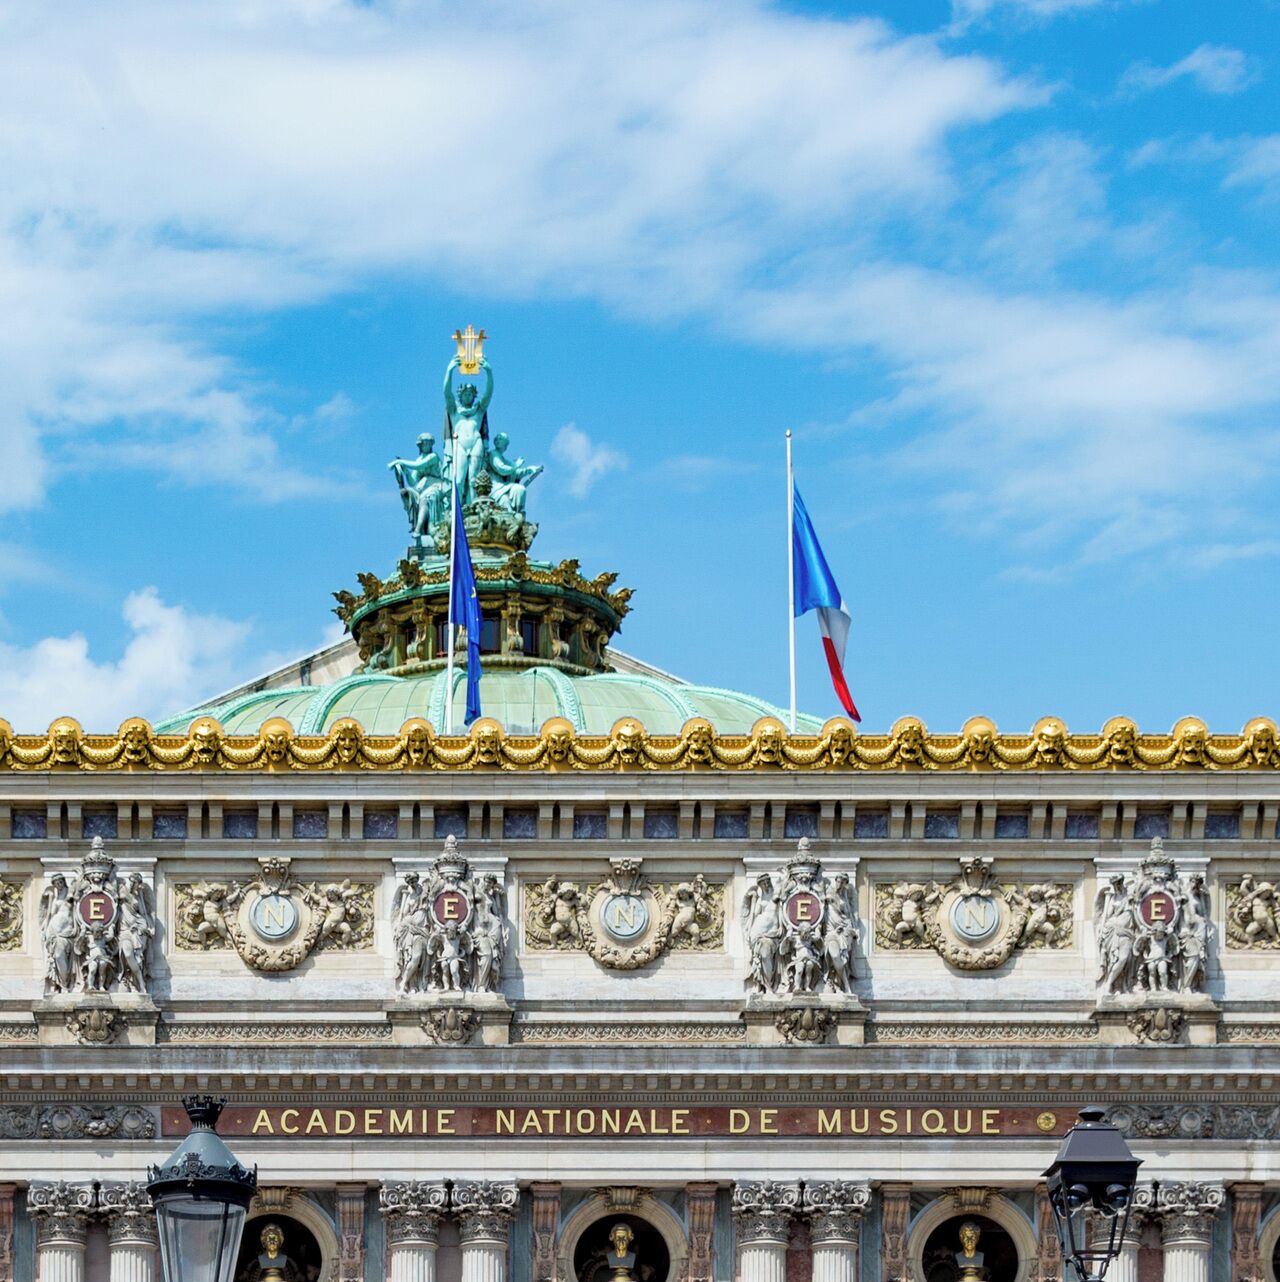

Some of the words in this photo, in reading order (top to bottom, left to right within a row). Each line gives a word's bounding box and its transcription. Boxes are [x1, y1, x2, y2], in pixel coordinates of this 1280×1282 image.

[88, 898, 105, 920] E
[264, 904, 285, 929] N
[443, 898, 460, 919] E
[614, 904, 635, 929] N
[795, 899, 812, 921] E
[964, 904, 986, 929] N
[1150, 899, 1167, 920] E
[251, 1109, 456, 1134] ACADEMIE
[494, 1109, 691, 1134] NATIONALE
[729, 1109, 780, 1134] DE
[817, 1109, 1001, 1135] MUSIQUE
